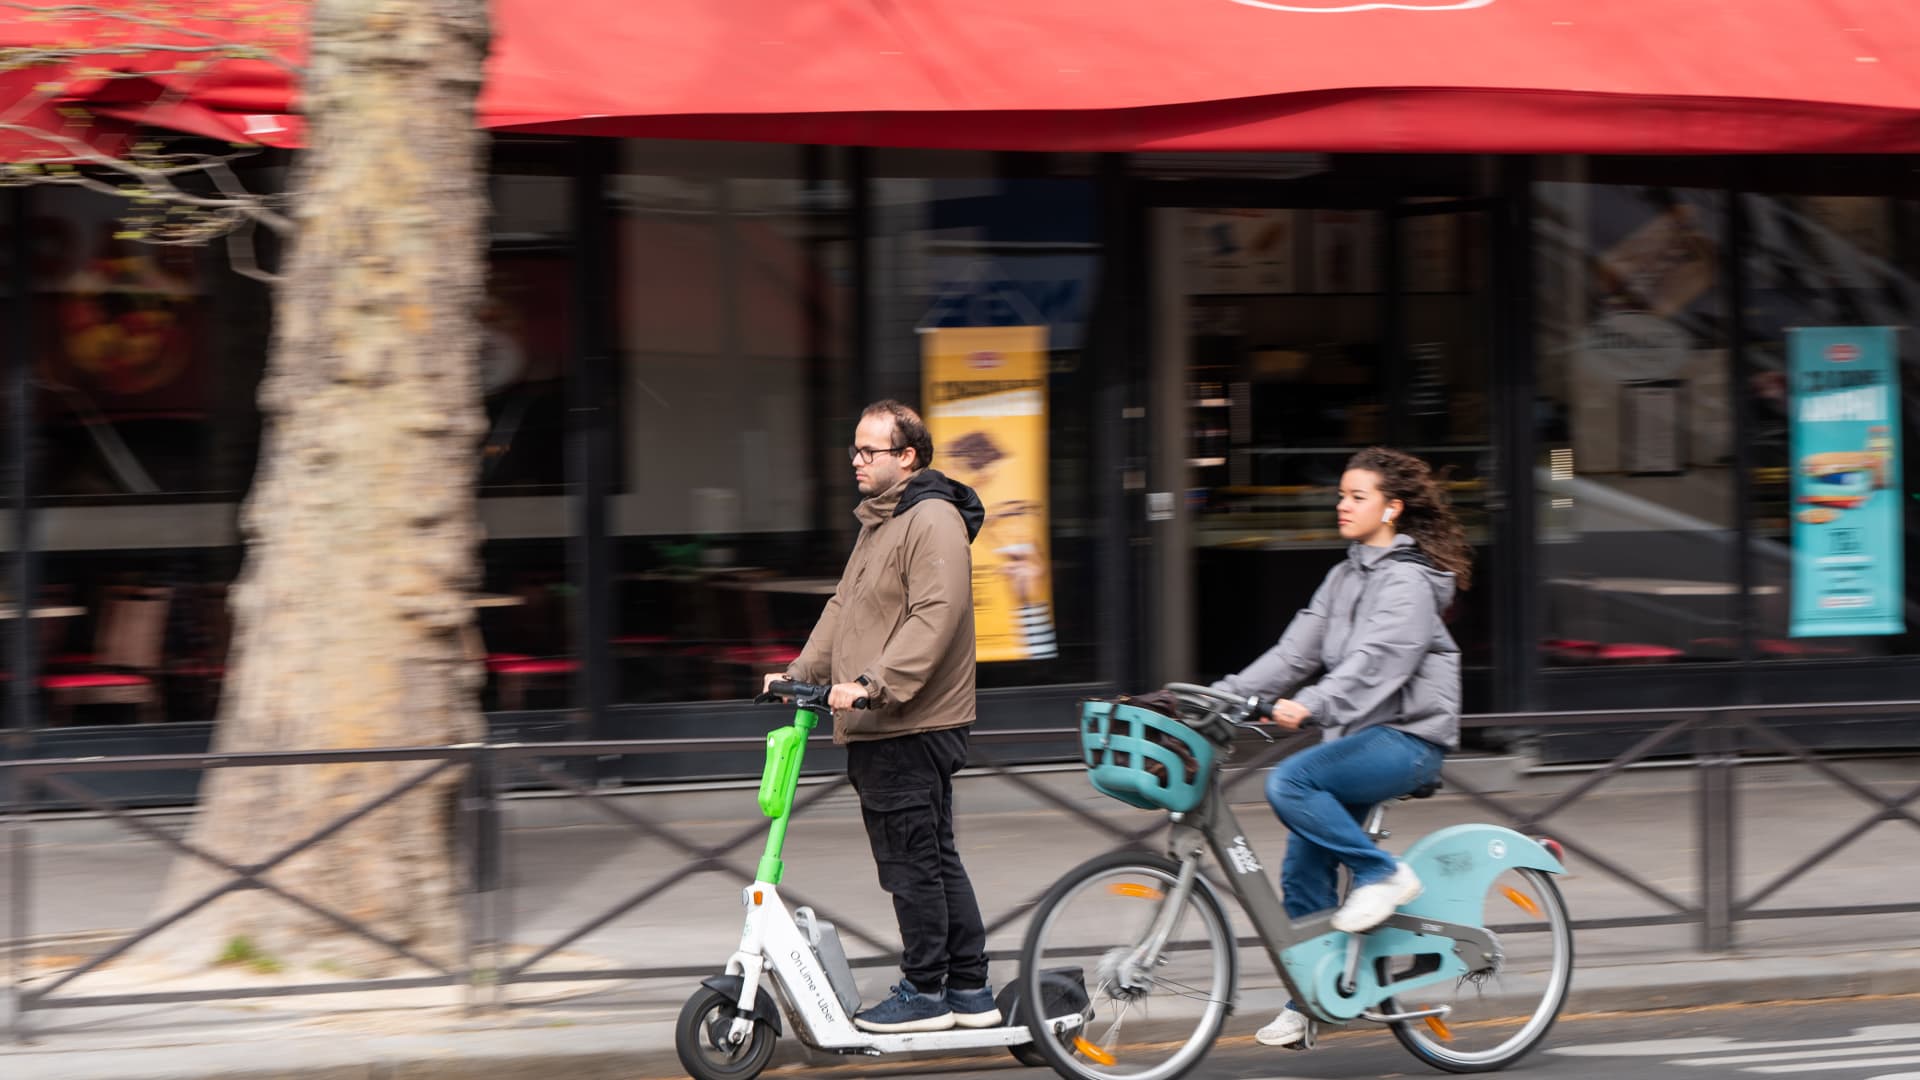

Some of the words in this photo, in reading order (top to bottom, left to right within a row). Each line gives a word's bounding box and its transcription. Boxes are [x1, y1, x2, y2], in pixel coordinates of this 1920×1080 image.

[791, 951, 802, 967] On
[800, 966, 816, 992] Lime
[818, 999, 834, 1023] Uber
